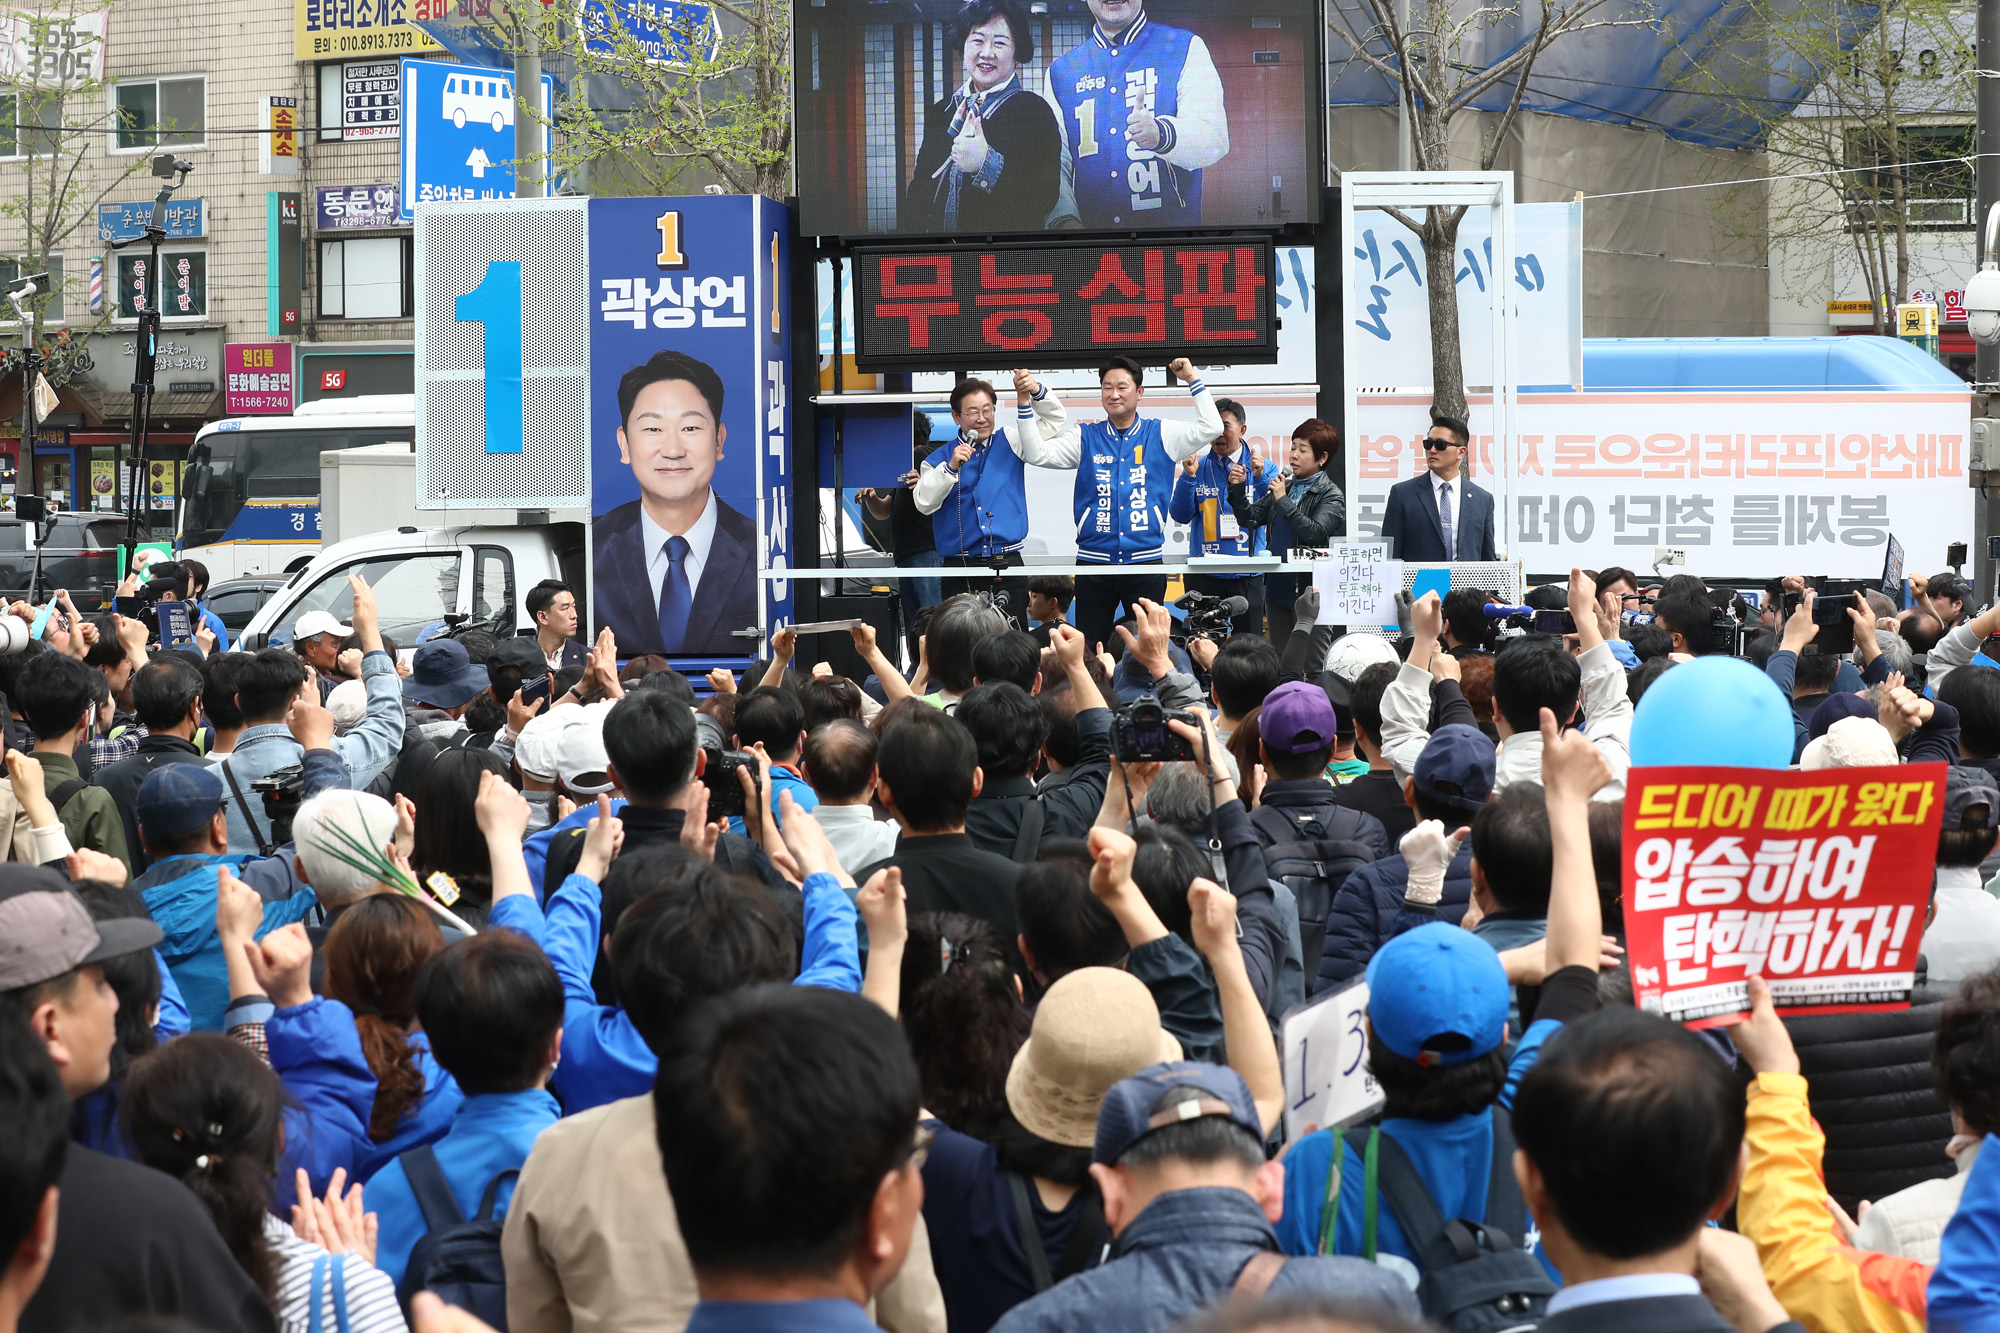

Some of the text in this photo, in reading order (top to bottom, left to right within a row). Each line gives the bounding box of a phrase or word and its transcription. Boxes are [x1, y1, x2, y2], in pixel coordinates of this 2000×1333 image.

[314, 38, 331, 53] 문의
[340, 32, 413, 51] 010.8913.7373
[27, 50, 92, 80] 3305
[347, 80, 396, 93] 무료 청력검사
[272, 98, 295, 107] 로타리
[276, 109, 293, 156] 소개소
[1074, 98, 1099, 158] 1
[282, 200, 297, 218] kt
[655, 211, 684, 265] 1
[177, 258, 191, 311] 준이발
[601, 275, 747, 330] 곽상언
[1843, 303, 1857, 311] 순대국
[285, 312, 295, 321] 5G
[242, 348, 274, 368] 원더풀
[455, 261, 523, 453] 1
[228, 372, 291, 392] 문화예술공연
[325, 373, 341, 387] 5G
[230, 397, 289, 408] T:1566-7240
[37, 430, 65, 444] 4시영업
[1134, 444, 1143, 465] 1
[1095, 469, 1112, 526] 국회의원
[1129, 464, 1149, 532] 곽상언
[1095, 525, 1111, 533] 후보
[1199, 498, 1218, 542] 1
[1338, 546, 1383, 565] 투표하면
[1340, 564, 1375, 582] 이긴다
[1337, 581, 1383, 598] 투표해야
[1339, 598, 1376, 614] 이긴다
[1634, 780, 1935, 831] 드디어 때가 왔다
[1634, 834, 1878, 912] 압승하여
[1662, 904, 1915, 986] 탄핵하자!
